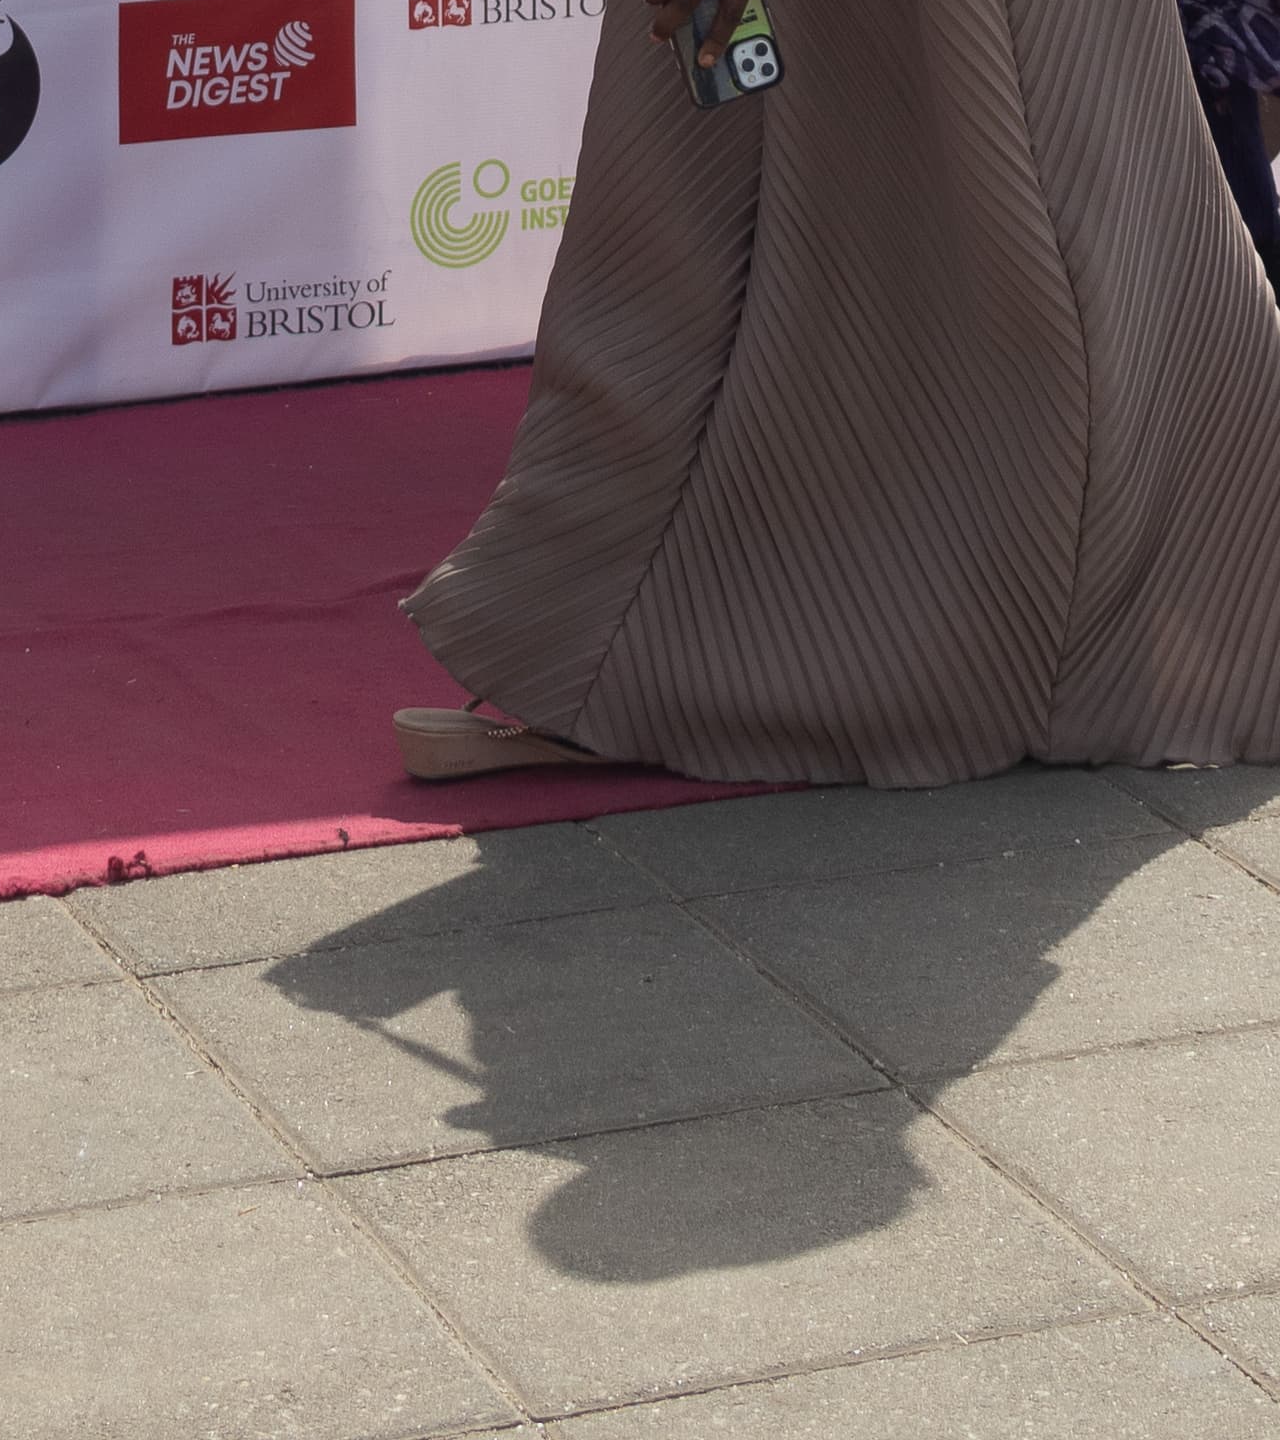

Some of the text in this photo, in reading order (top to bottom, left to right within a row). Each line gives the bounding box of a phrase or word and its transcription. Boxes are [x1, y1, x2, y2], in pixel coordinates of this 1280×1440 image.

[173, 34, 194, 44] THE
[167, 43, 267, 77] NEWS
[167, 72, 290, 109] DIGEST
[521, 177, 577, 202] GOE
[521, 205, 570, 231] INST
[247, 270, 392, 303] University of
[247, 300, 395, 338] BRISTOL
